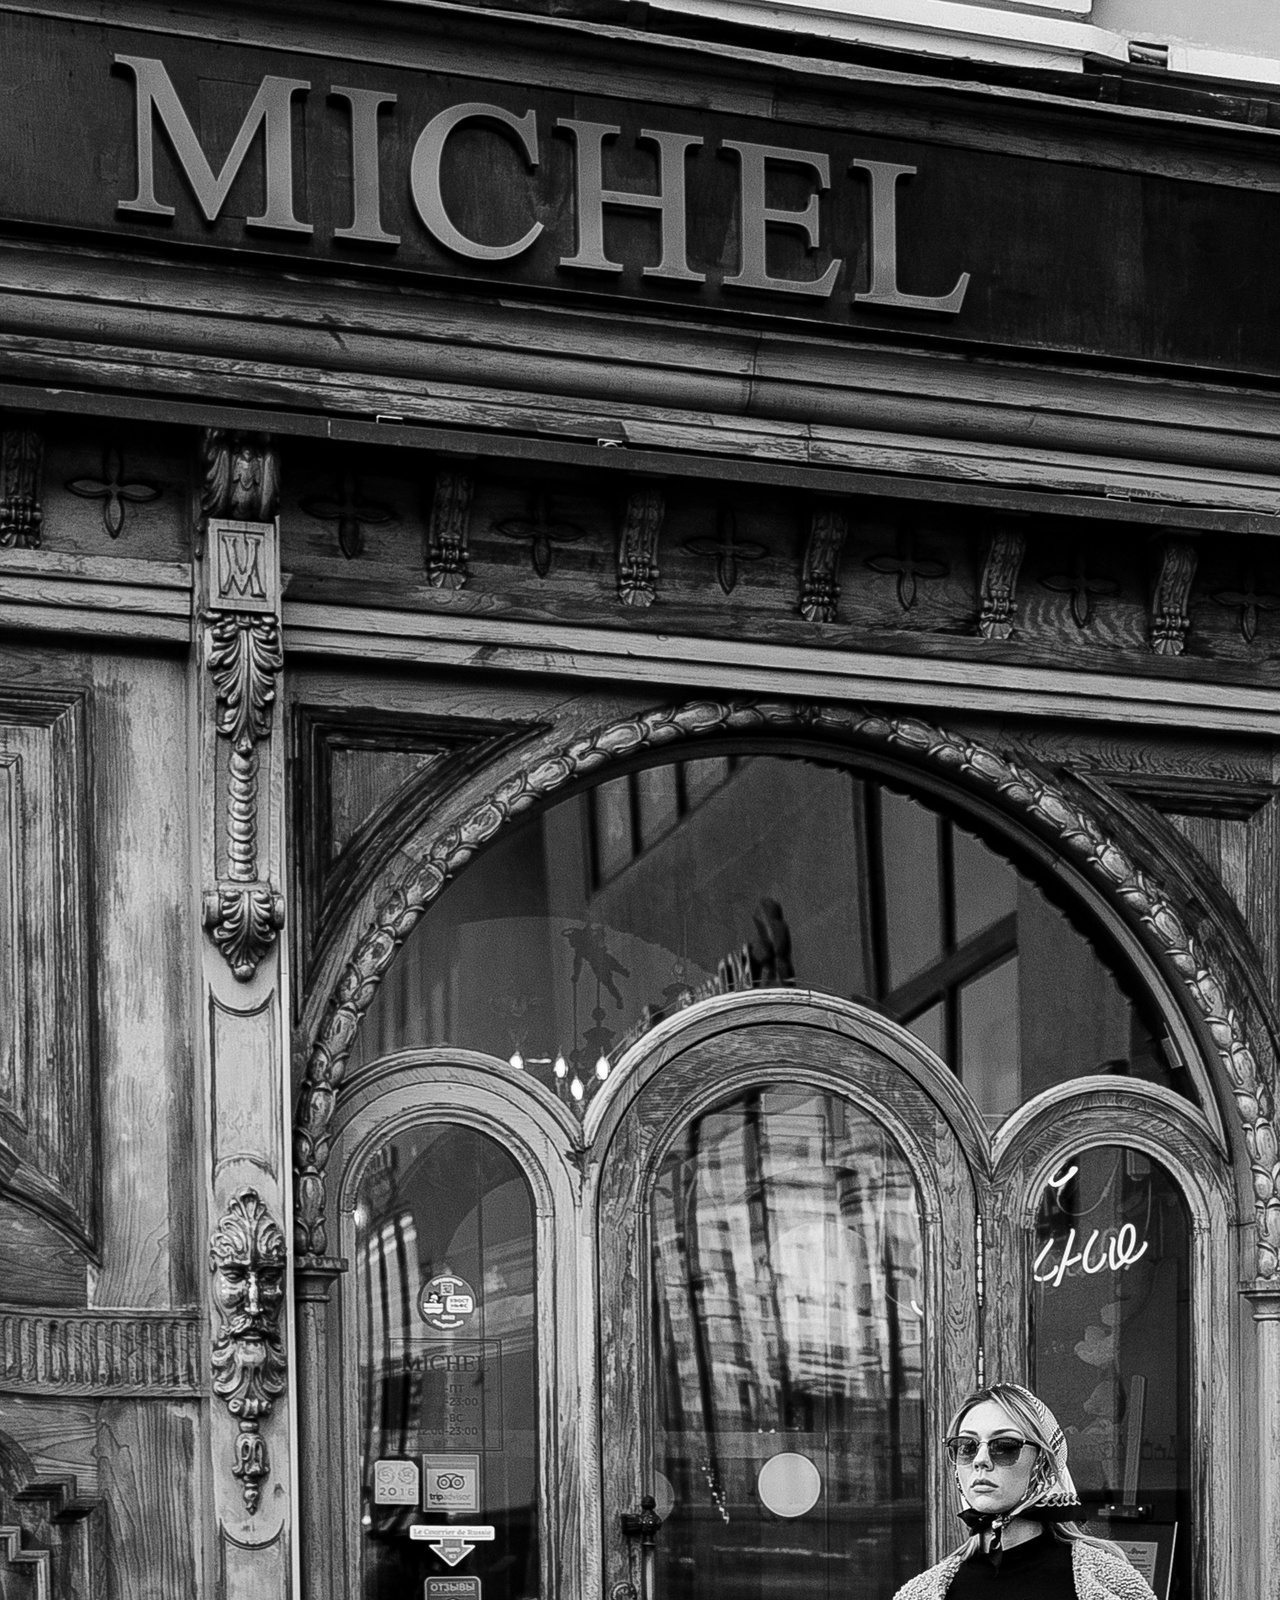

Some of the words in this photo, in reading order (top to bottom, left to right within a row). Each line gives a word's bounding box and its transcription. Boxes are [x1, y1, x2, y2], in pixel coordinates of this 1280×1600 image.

[114, 53, 971, 315] MICHEL
[402, 1354, 490, 1373] MICHEL
[379, 1487, 415, 1496] 2016
[430, 1583, 475, 1591] ОТЗЫВЫ
